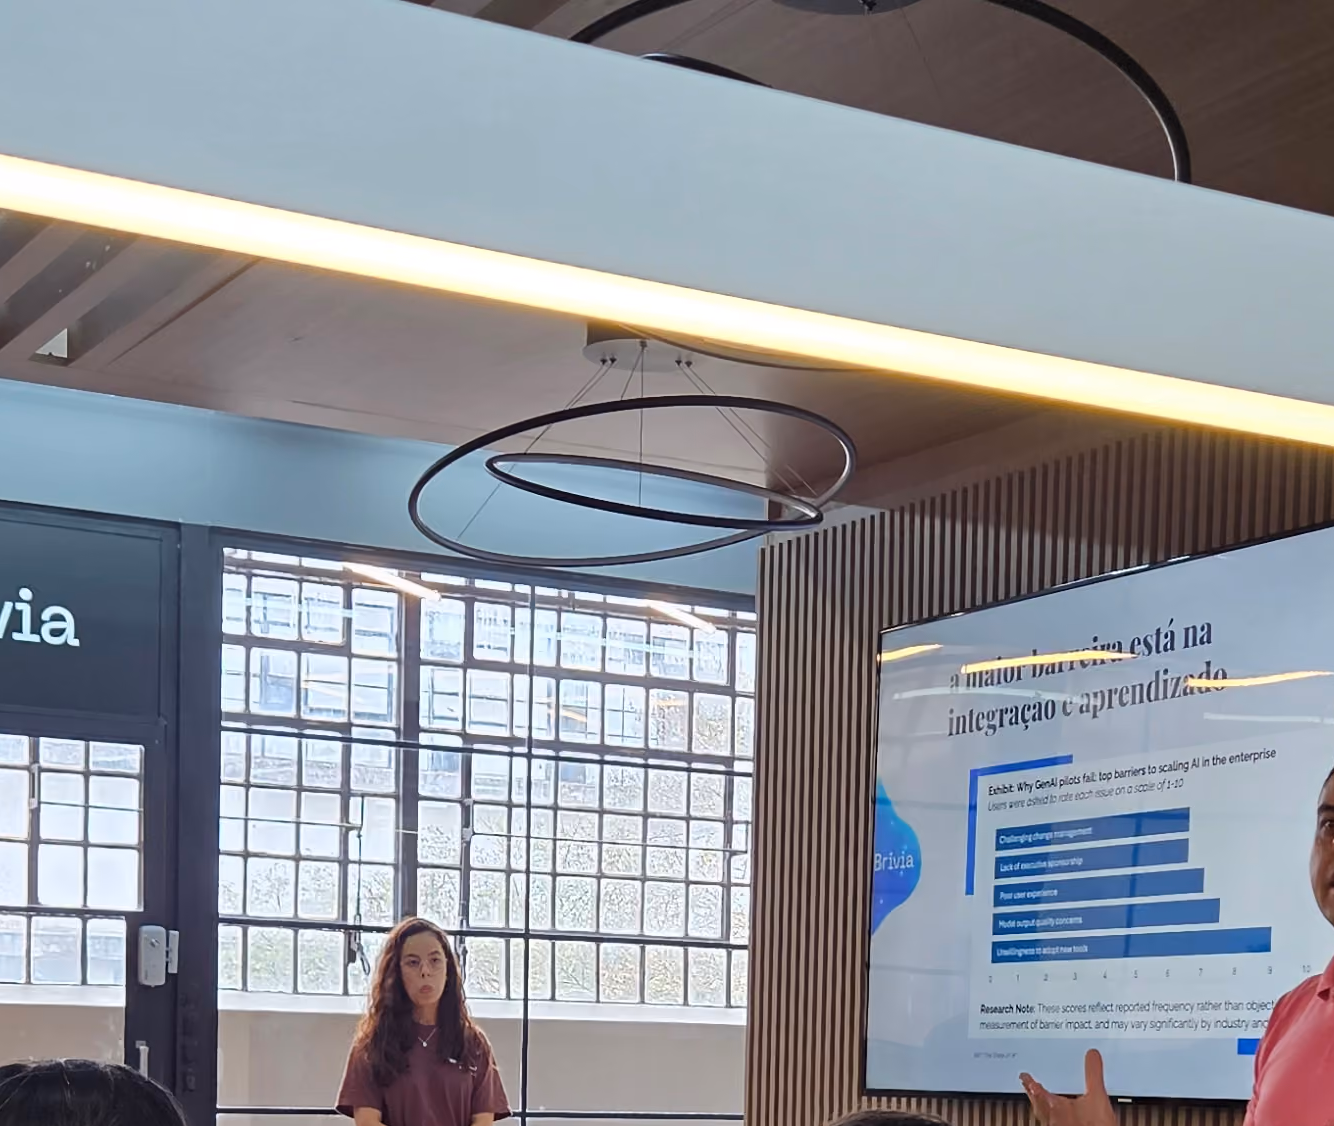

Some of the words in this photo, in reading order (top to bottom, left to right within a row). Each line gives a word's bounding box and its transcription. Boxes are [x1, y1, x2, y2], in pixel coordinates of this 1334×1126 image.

[950, 672, 959, 690] a
[967, 656, 1024, 689] maior
[1130, 618, 1176, 656] está
[1183, 621, 1213, 649] na
[948, 696, 1056, 736] integração
[1062, 699, 1073, 717] e
[1079, 660, 1228, 719] aprendizado
[1017, 782, 1033, 793] Why
[1035, 778, 1058, 790] GenAI
[1059, 776, 1081, 789] pilots
[1099, 771, 1112, 783] top
[1114, 766, 1146, 780] barriers
[1148, 765, 1156, 776] to
[1158, 760, 1189, 774] scaling
[1191, 758, 1200, 769] AI
[1202, 756, 1210, 767] in
[1212, 754, 1227, 766] the
[1229, 748, 1276, 764] enterprise
[1114, 786, 1126, 797] on
[1127, 784, 1133, 794] a
[1157, 778, 1166, 792] of
[1167, 778, 1184, 789] 1-10
[875, 851, 915, 872] Brivia
[980, 1003, 1013, 1014] Research
[1016, 1003, 1035, 1014] Note:
[1037, 1003, 1060, 1013] These
[1061, 1004, 1086, 1013] scores
[1089, 1002, 1114, 1013] reflect
[1116, 1001, 1150, 1014] reported
[1152, 1001, 1194, 1014] frequency
[1196, 1000, 1222, 1011] rather
[1224, 1000, 1244, 1011] than
[980, 1020, 1029, 1031] measurement
[1030, 1019, 1038, 1030] of
[1039, 1019, 1065, 1030] barrier
[1094, 1018, 1109, 1029] and
[1111, 1020, 1128, 1032] may
[1130, 1020, 1148, 1032] vary
[1150, 1017, 1199, 1031] significantly
[1201, 1018, 1212, 1031] by
[1214, 1017, 1249, 1031] industry
